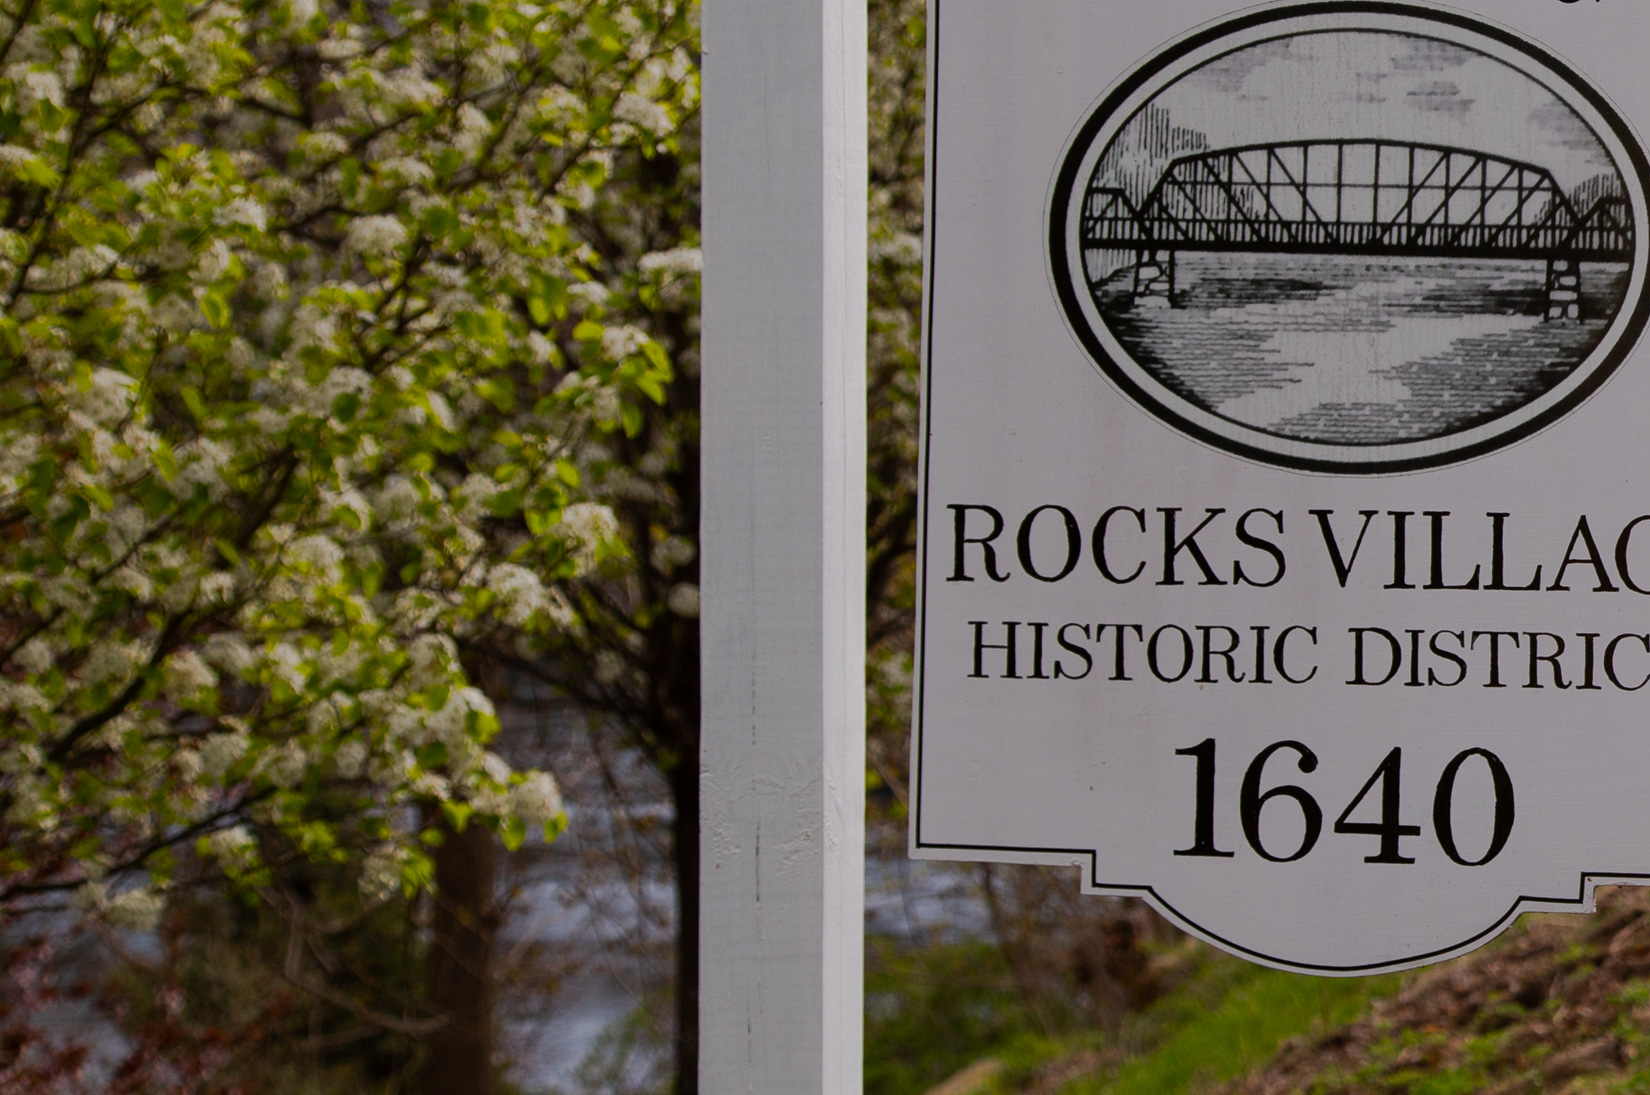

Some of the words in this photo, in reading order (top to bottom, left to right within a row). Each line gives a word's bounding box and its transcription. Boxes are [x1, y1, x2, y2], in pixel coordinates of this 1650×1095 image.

[945, 503, 1287, 588] ROCKS
[966, 620, 1318, 685] HISTORIC
[1172, 737, 1516, 867] 1640
